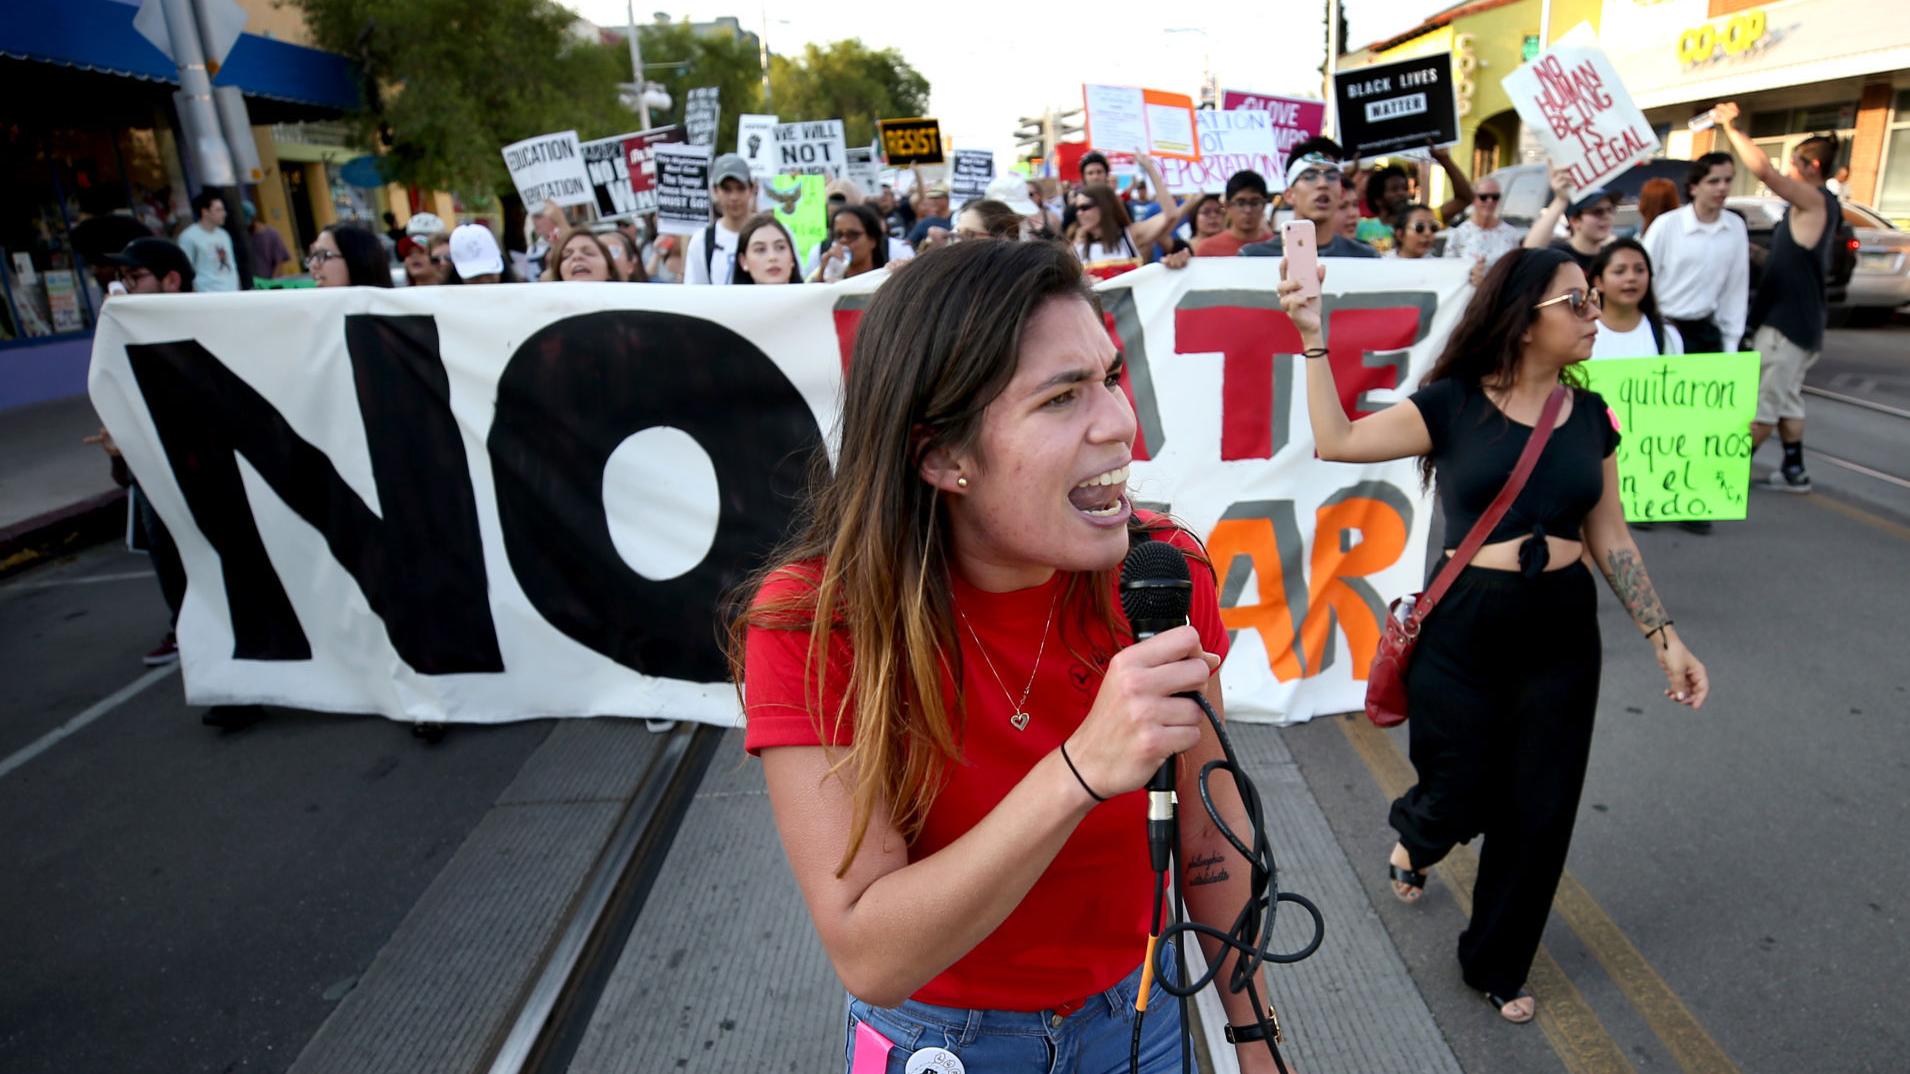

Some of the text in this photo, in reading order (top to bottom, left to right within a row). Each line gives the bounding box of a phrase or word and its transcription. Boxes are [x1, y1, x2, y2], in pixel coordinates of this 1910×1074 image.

[1677, 11, 1767, 64] CO-OP
[1347, 67, 1438, 99] BLACK LIVES
[1197, 110, 1265, 131] ATION
[1372, 97, 1424, 117] MATTER
[772, 121, 837, 141] WE WILL
[883, 127, 938, 156] RESIST
[1202, 130, 1230, 152] OT
[1572, 119, 1605, 153] IS
[780, 142, 832, 164] NOT
[1567, 125, 1653, 191] ILLEGAL
[1620, 364, 1736, 433] quitaron
[1640, 434, 1688, 473] que
[1705, 432, 1752, 459] nos
[1662, 460, 1698, 492] el
[126, 308, 836, 684] NO
[1632, 493, 1712, 518] iedo.
[1200, 480, 1414, 683] AR
